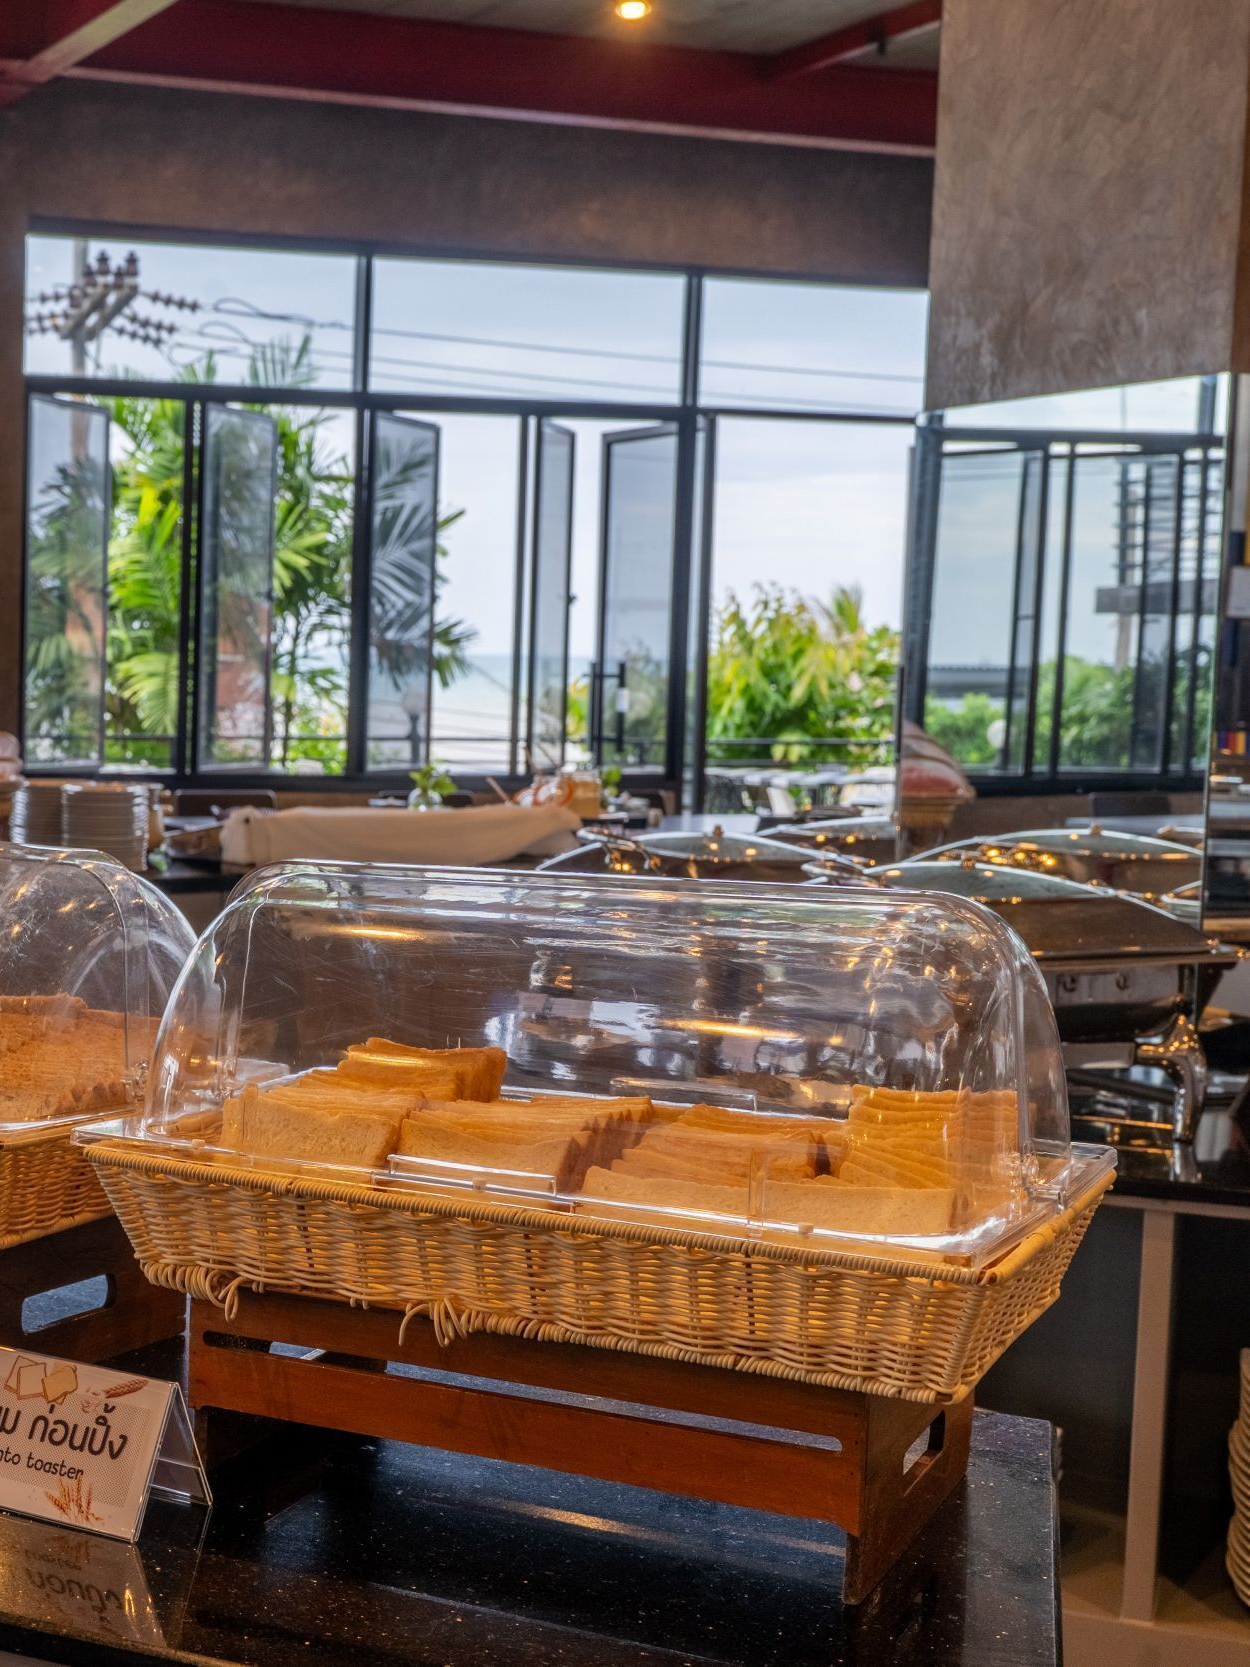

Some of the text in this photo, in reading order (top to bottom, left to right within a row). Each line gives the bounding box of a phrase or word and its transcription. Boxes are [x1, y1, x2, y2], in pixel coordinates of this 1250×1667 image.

[28, 1403, 128, 1460] ก่อนปิ้ง
[26, 1454, 84, 1480] toaster
